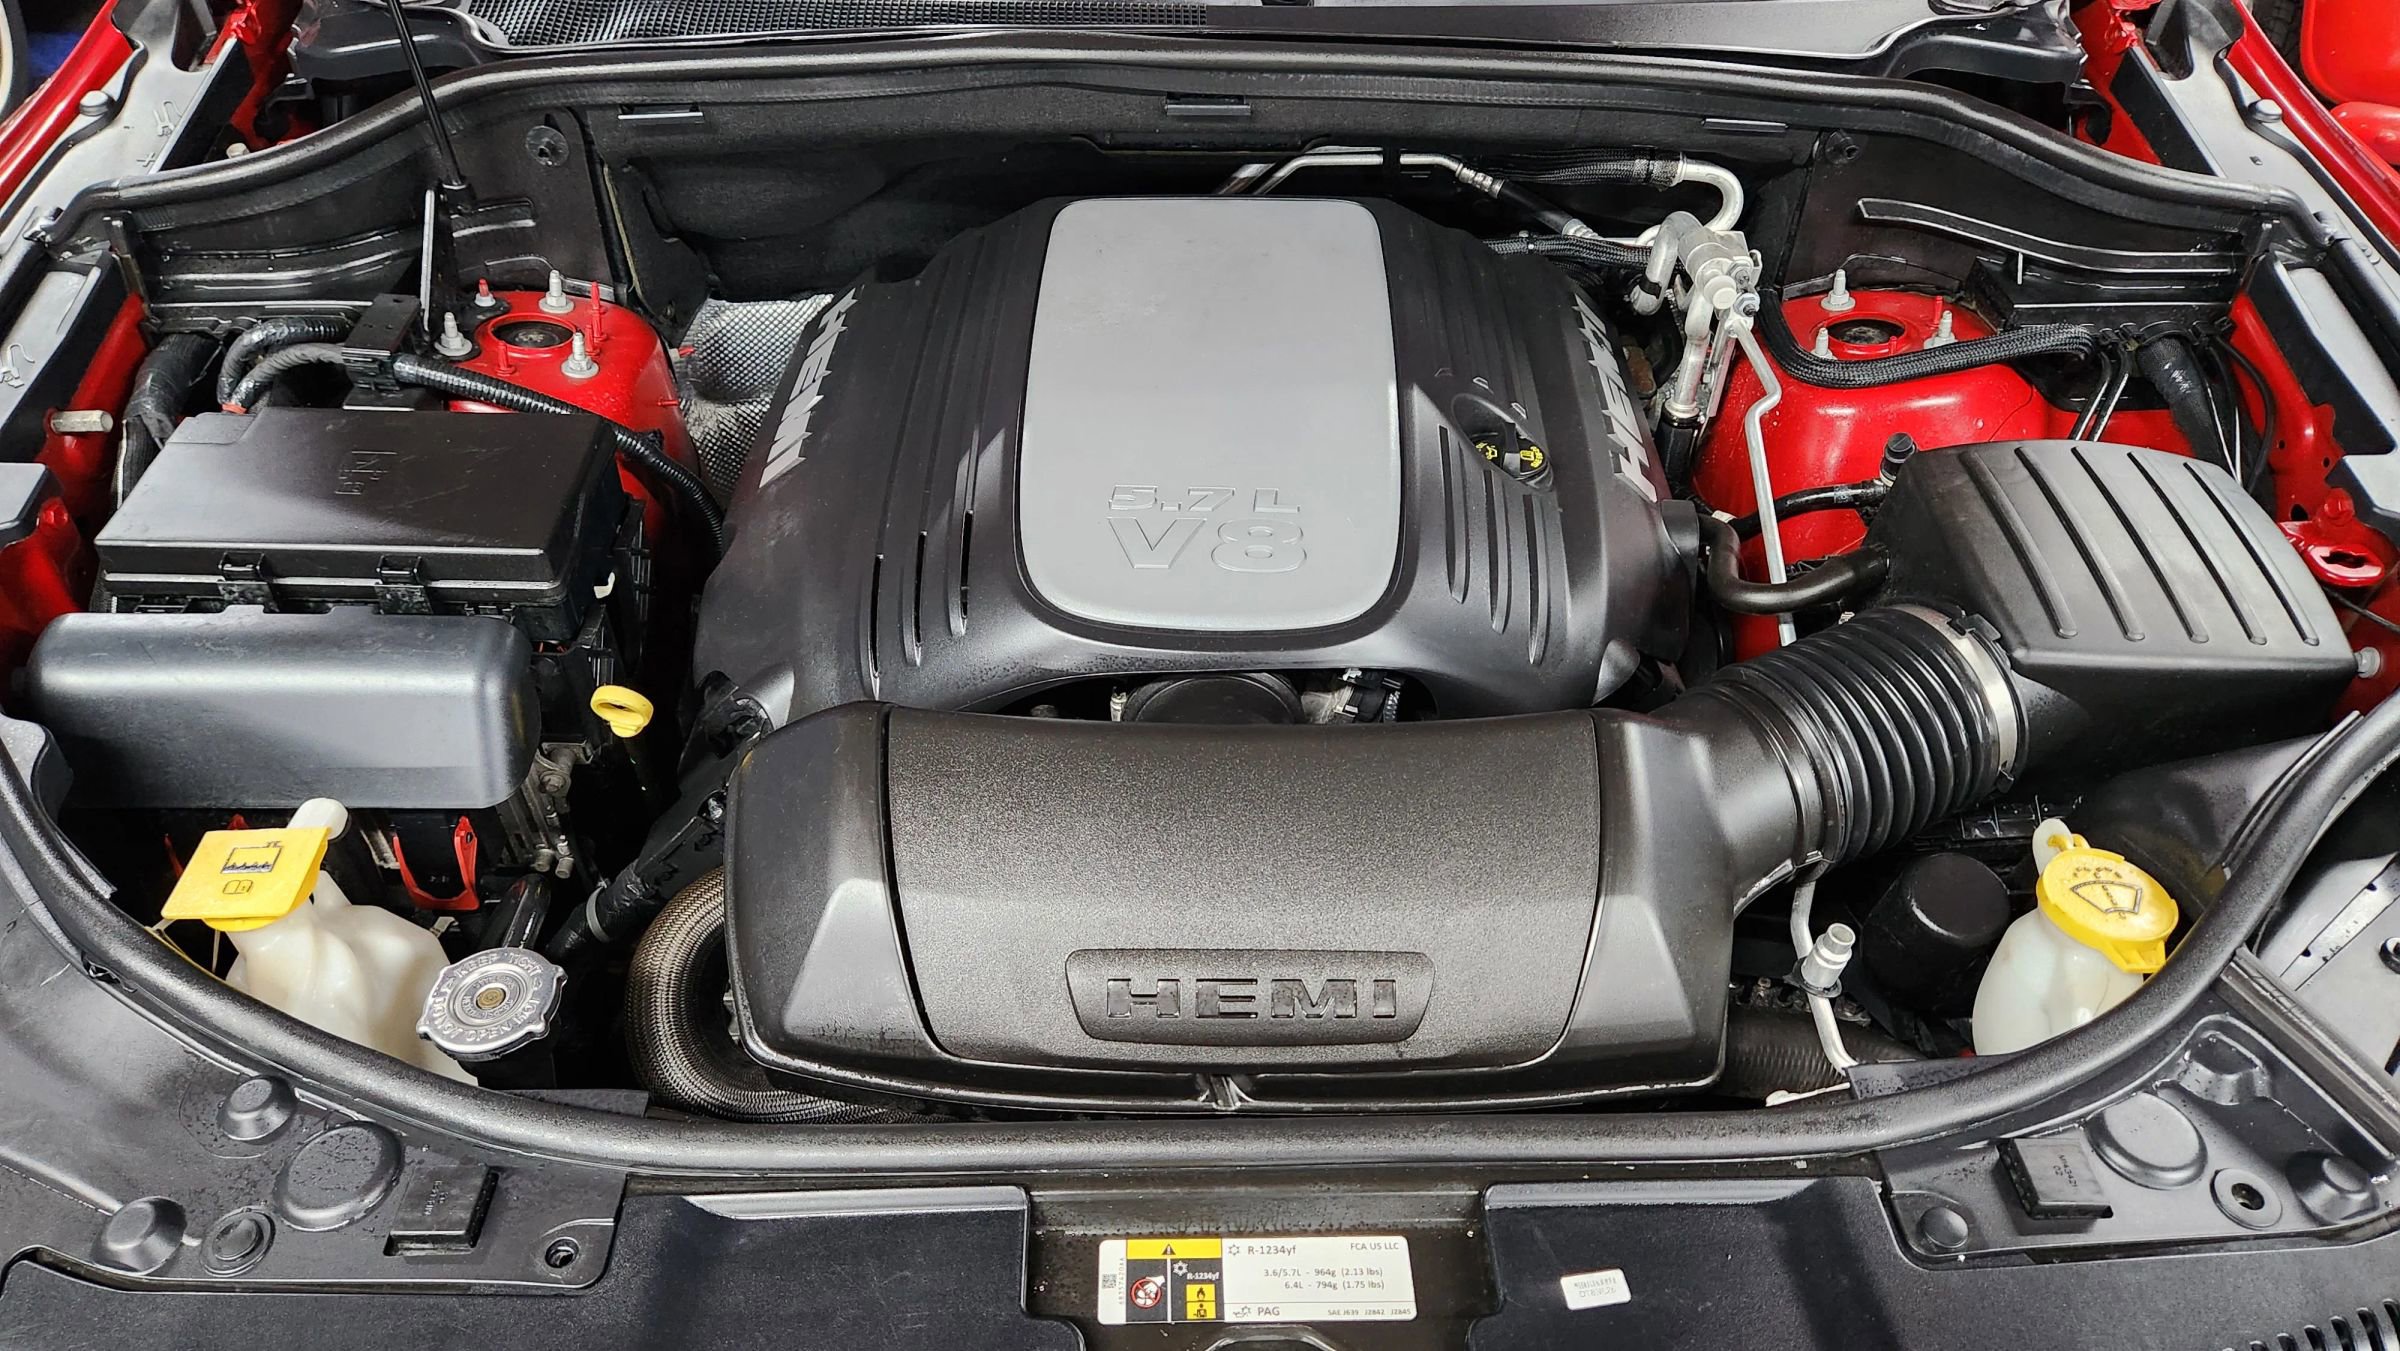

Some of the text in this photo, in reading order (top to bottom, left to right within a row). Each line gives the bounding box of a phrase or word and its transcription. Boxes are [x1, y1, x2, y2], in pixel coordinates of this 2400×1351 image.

[1105, 516, 1308, 573] V8
[454, 952, 544, 979] KEEP TIGHT
[1107, 979, 1396, 1018] HEMI
[466, 1023, 513, 1042] OPEN
[1247, 1245, 1296, 1257] R-1234yf
[1350, 1242, 1399, 1251] FCA US LLC
[1263, 1268, 1302, 1278] 3.6/5.7L
[1314, 1268, 1336, 1278] 964g
[1341, 1267, 1364, 1278] (2.13
[1366, 1267, 1383, 1278] lbs)
[1284, 1281, 1304, 1289] 6.4L
[1316, 1280, 1338, 1290] 794g
[1342, 1280, 1366, 1290] (1.75
[1367, 1280, 1384, 1290] lbs)
[1257, 1306, 1280, 1316] PAG
